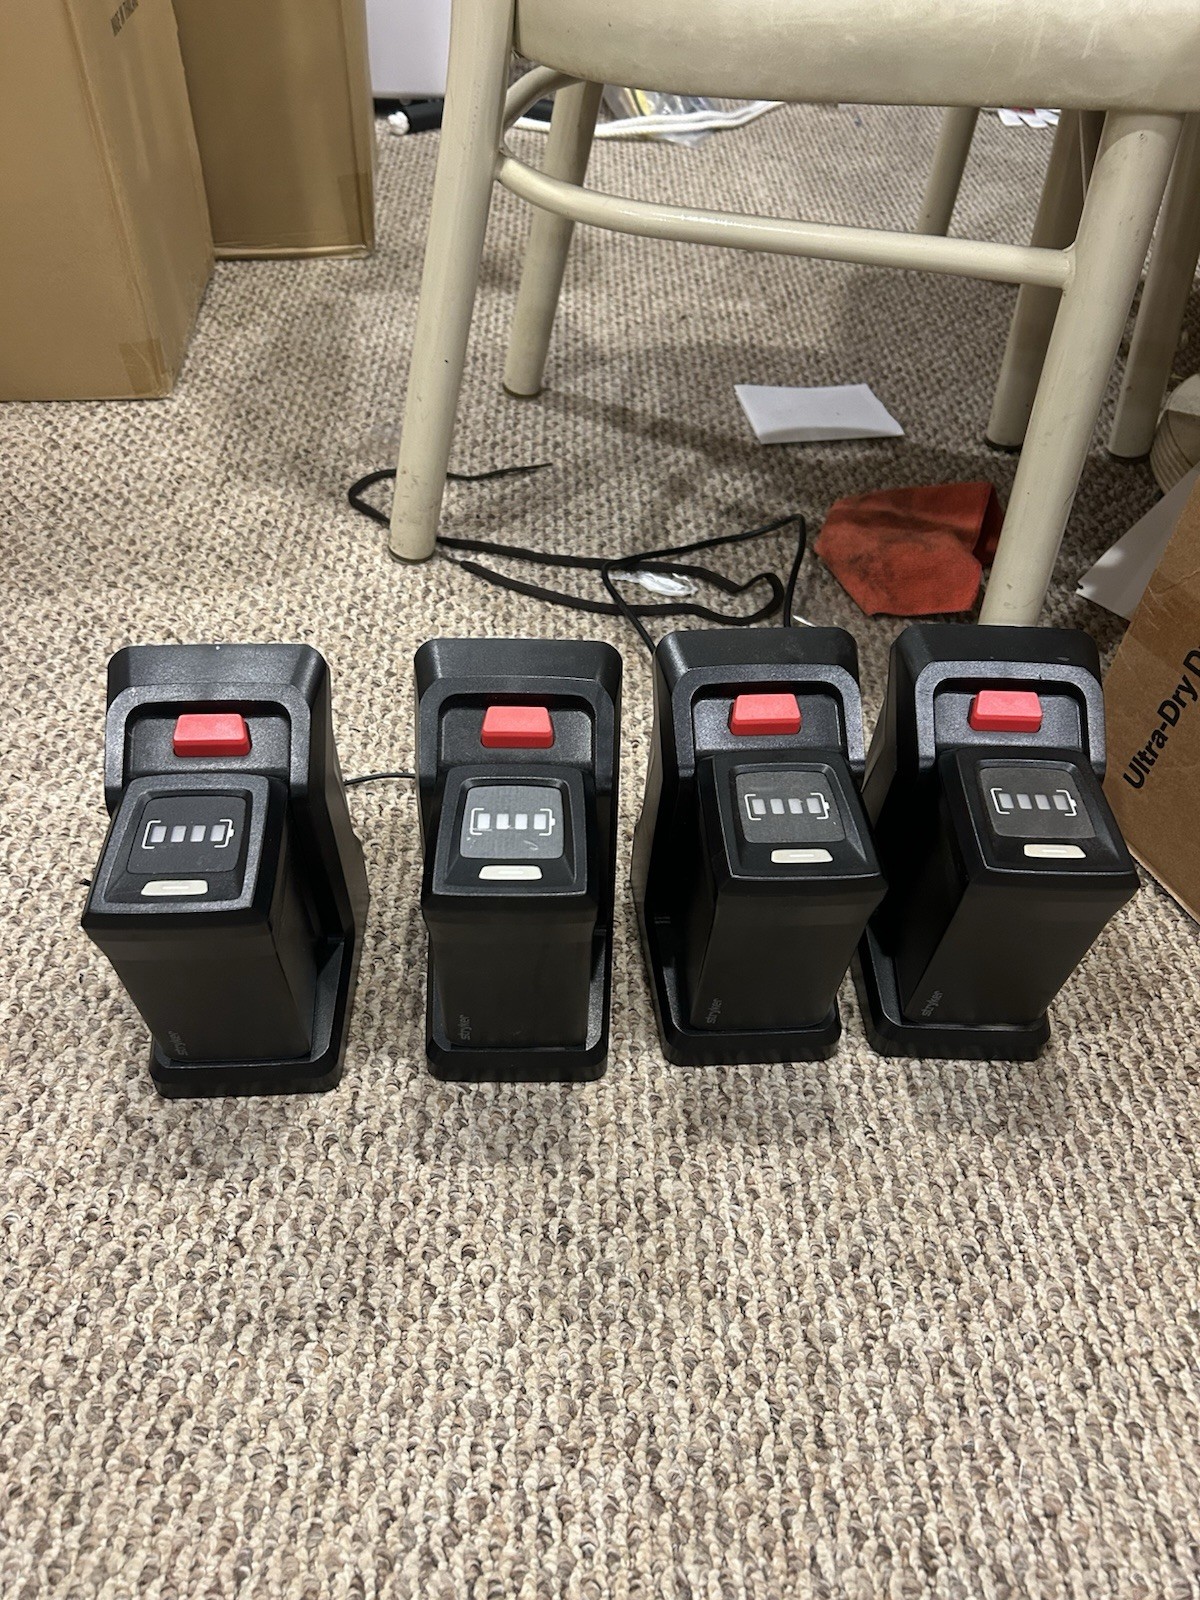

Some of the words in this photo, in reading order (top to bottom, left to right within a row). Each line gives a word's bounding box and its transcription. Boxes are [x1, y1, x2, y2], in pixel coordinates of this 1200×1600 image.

[1123, 674, 1198, 789] Ultra-Dry
[706, 997, 722, 1024] stryker
[921, 990, 943, 1017] stryker
[459, 1014, 472, 1040] stryker
